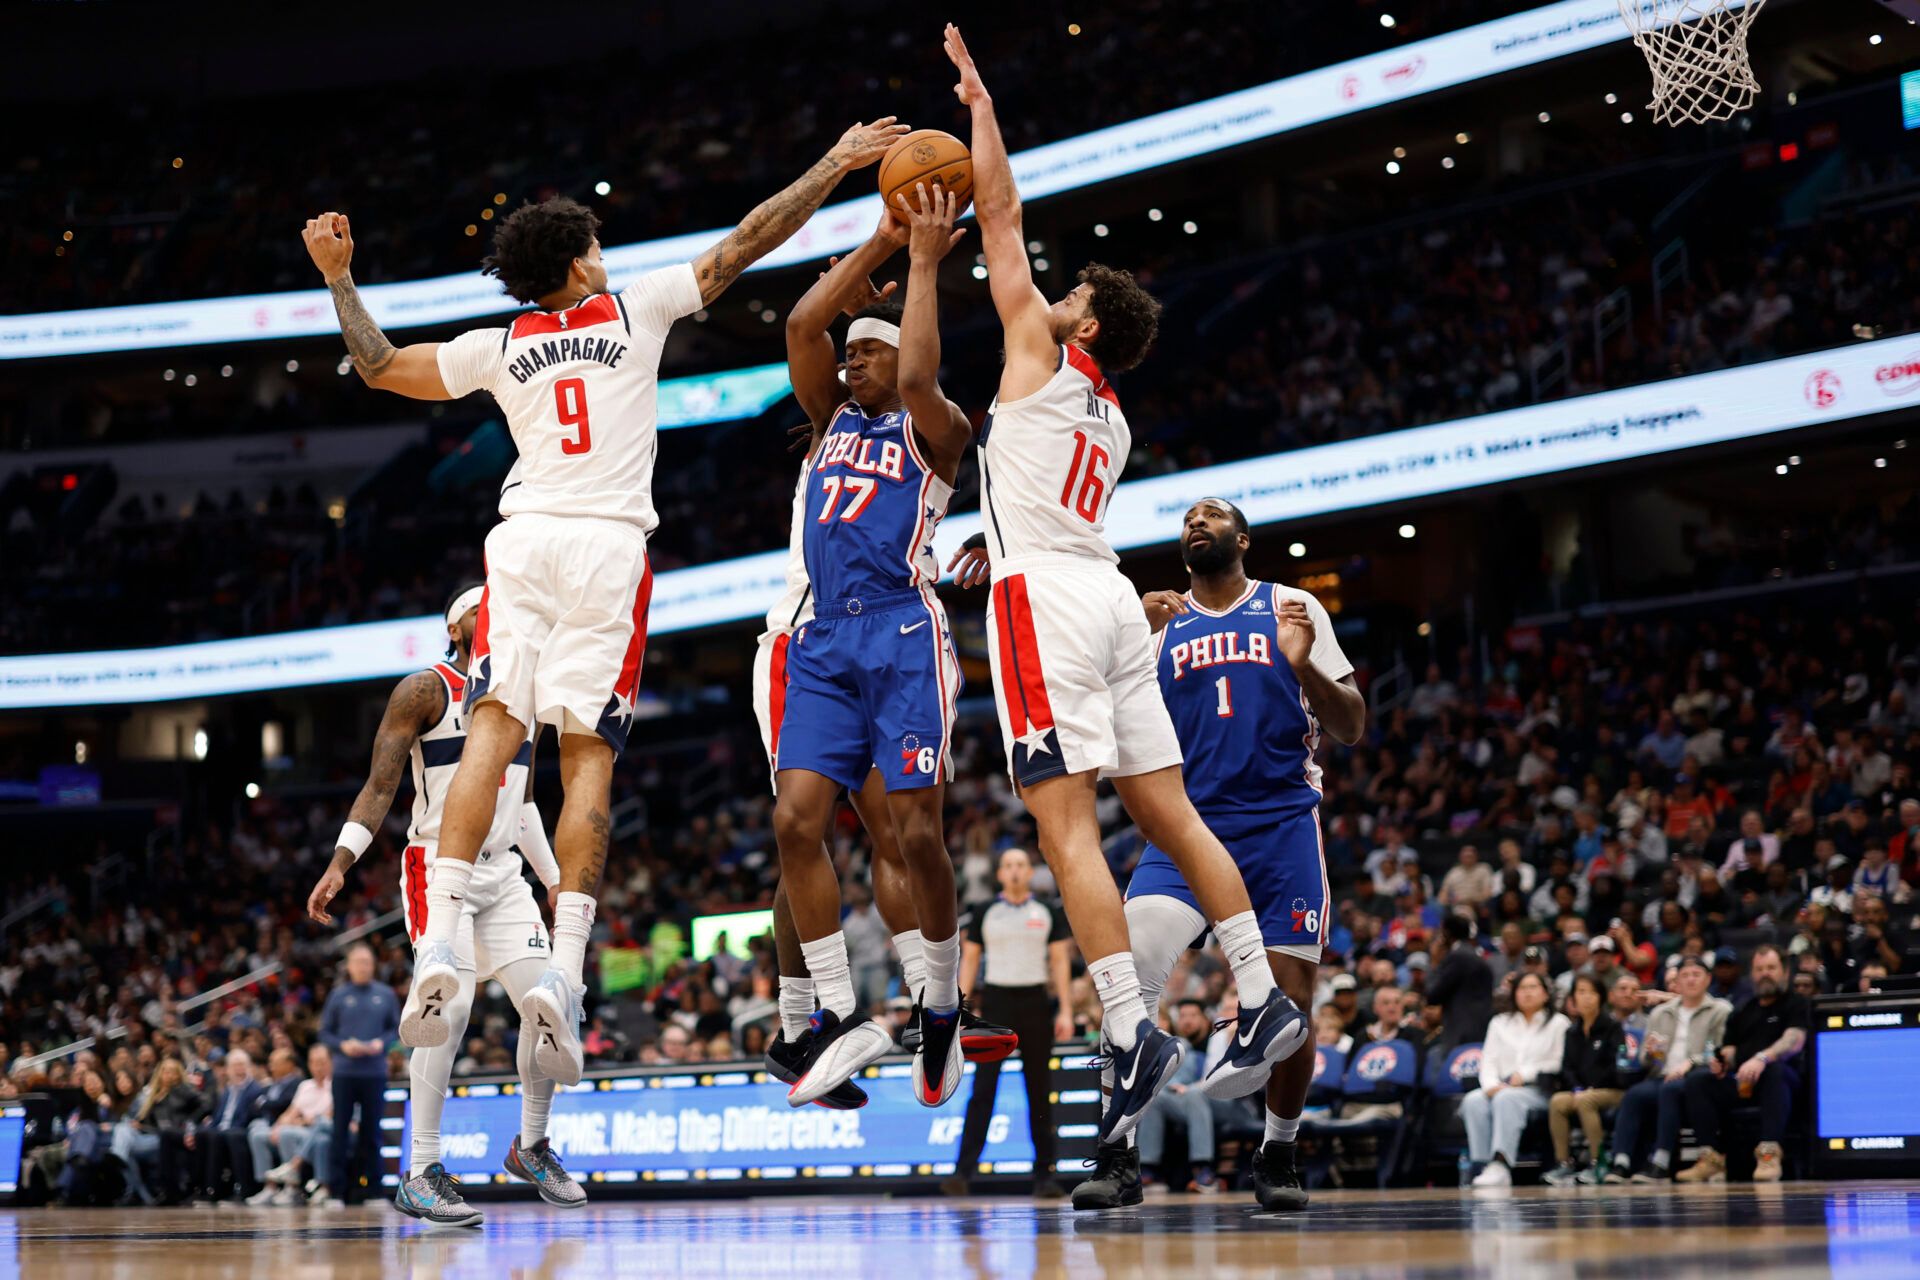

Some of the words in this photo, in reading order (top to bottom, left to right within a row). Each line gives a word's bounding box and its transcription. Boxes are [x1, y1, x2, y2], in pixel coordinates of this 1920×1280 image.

[508, 337, 628, 384] CHAMPAGNIE
[554, 377, 591, 455] 9
[817, 431, 905, 482] PHILA
[1060, 430, 1109, 523] 16
[818, 476, 878, 524] 77
[1170, 631, 1273, 681] PHILA
[1215, 676, 1233, 717] 1
[901, 746, 935, 775] 76
[528, 925, 545, 948] dc
[1291, 909, 1319, 934] 76
[440, 1132, 489, 1159] PMG
[611, 1109, 677, 1154] Make
[678, 1107, 721, 1152] the
[722, 1105, 865, 1151] Difference.
[928, 1114, 1011, 1145] KPG
